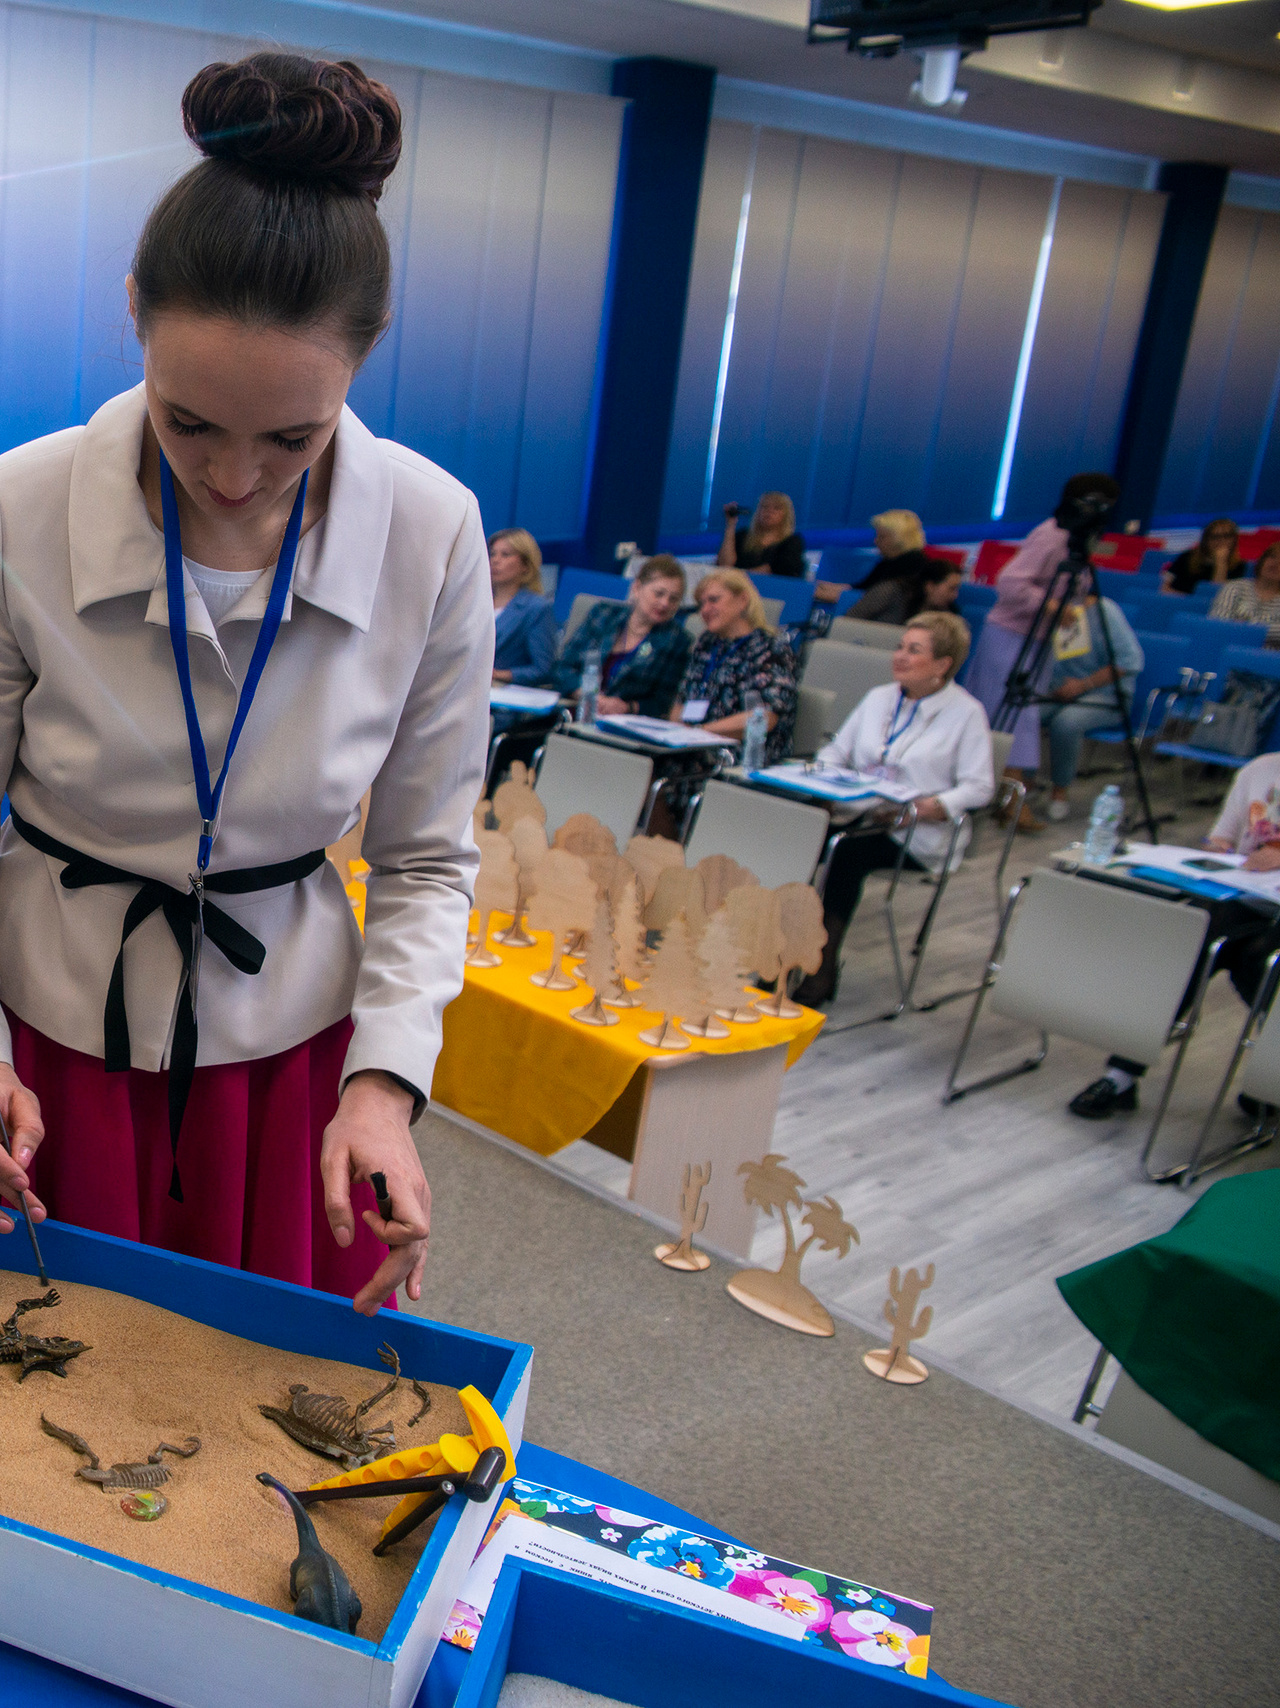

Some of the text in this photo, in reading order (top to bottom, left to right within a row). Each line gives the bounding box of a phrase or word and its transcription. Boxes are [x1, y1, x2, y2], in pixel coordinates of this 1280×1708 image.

[525, 1549, 554, 1564] песком
[528, 1541, 588, 1565] деятельности?
[589, 1563, 613, 1576] видах
[614, 1574, 639, 1587] каких
[651, 1588, 675, 1599] сада?
[676, 1596, 715, 1614] детского
